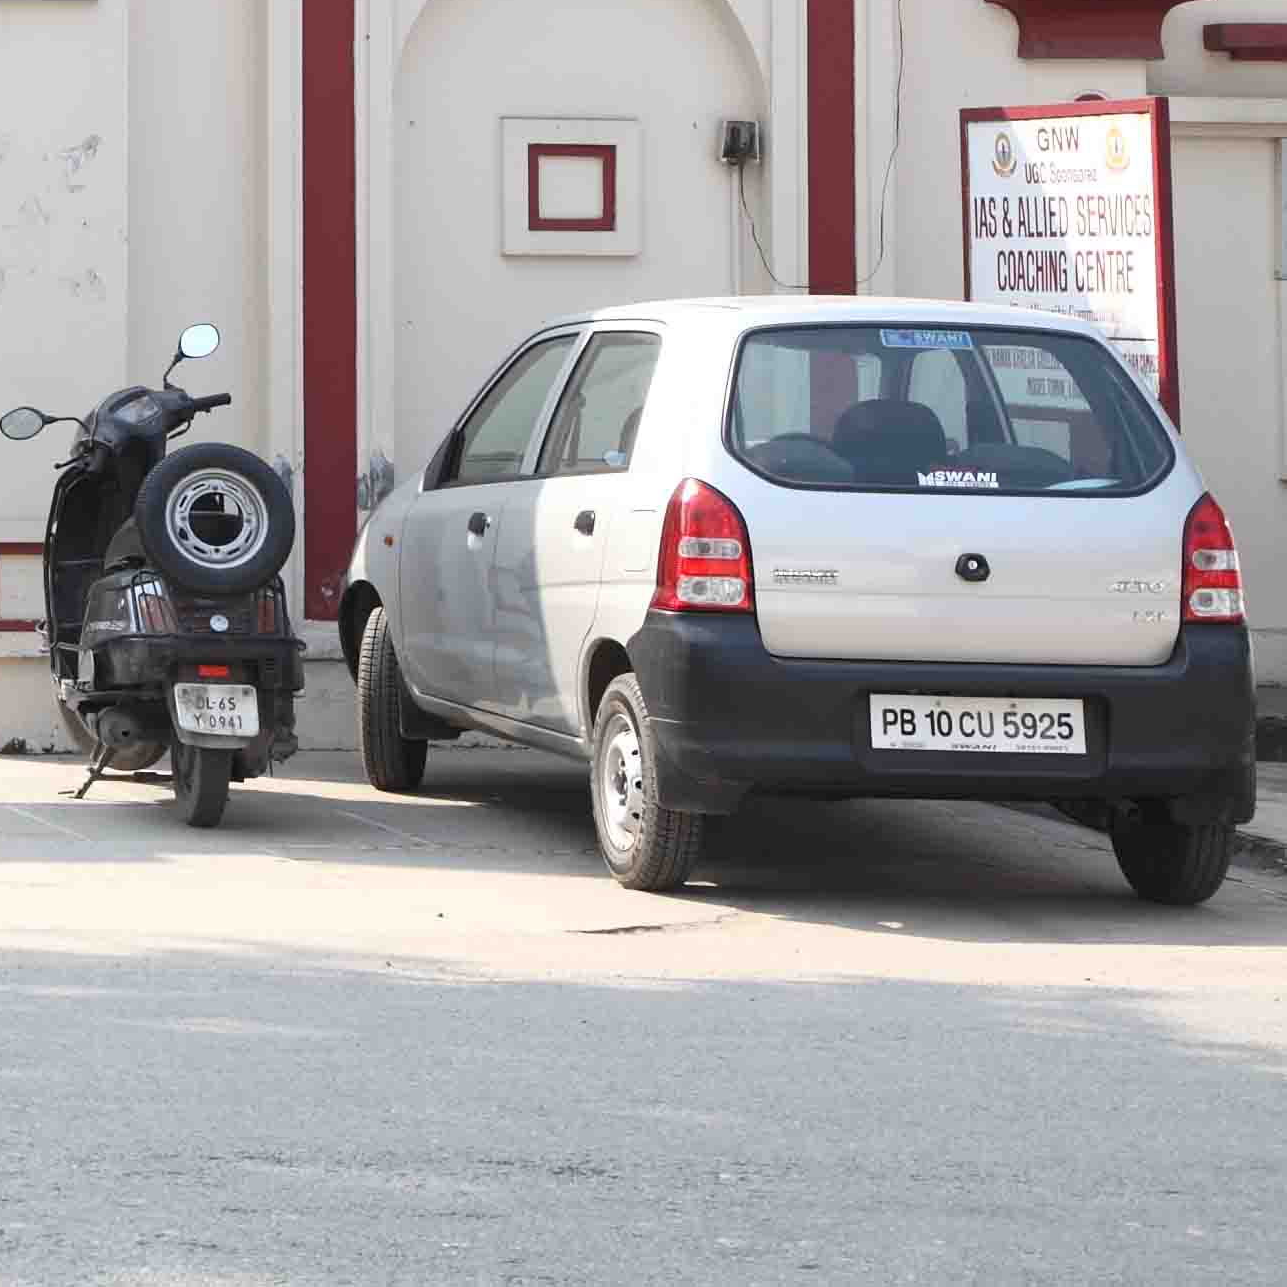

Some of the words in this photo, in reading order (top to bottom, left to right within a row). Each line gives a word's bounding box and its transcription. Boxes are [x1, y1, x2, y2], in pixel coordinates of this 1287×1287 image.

[973, 197, 997, 239] IAS
[1002, 197, 1013, 239] &
[1017, 196, 1069, 238] ALLIED
[1076, 194, 1152, 237] SERVICES
[997, 250, 1068, 292] COACHING
[1073, 250, 1135, 293] CENTRE
[882, 709, 916, 736] PB
[925, 710, 953, 737] 10
[959, 711, 995, 738] CU
[1003, 712, 1074, 740] 5925
